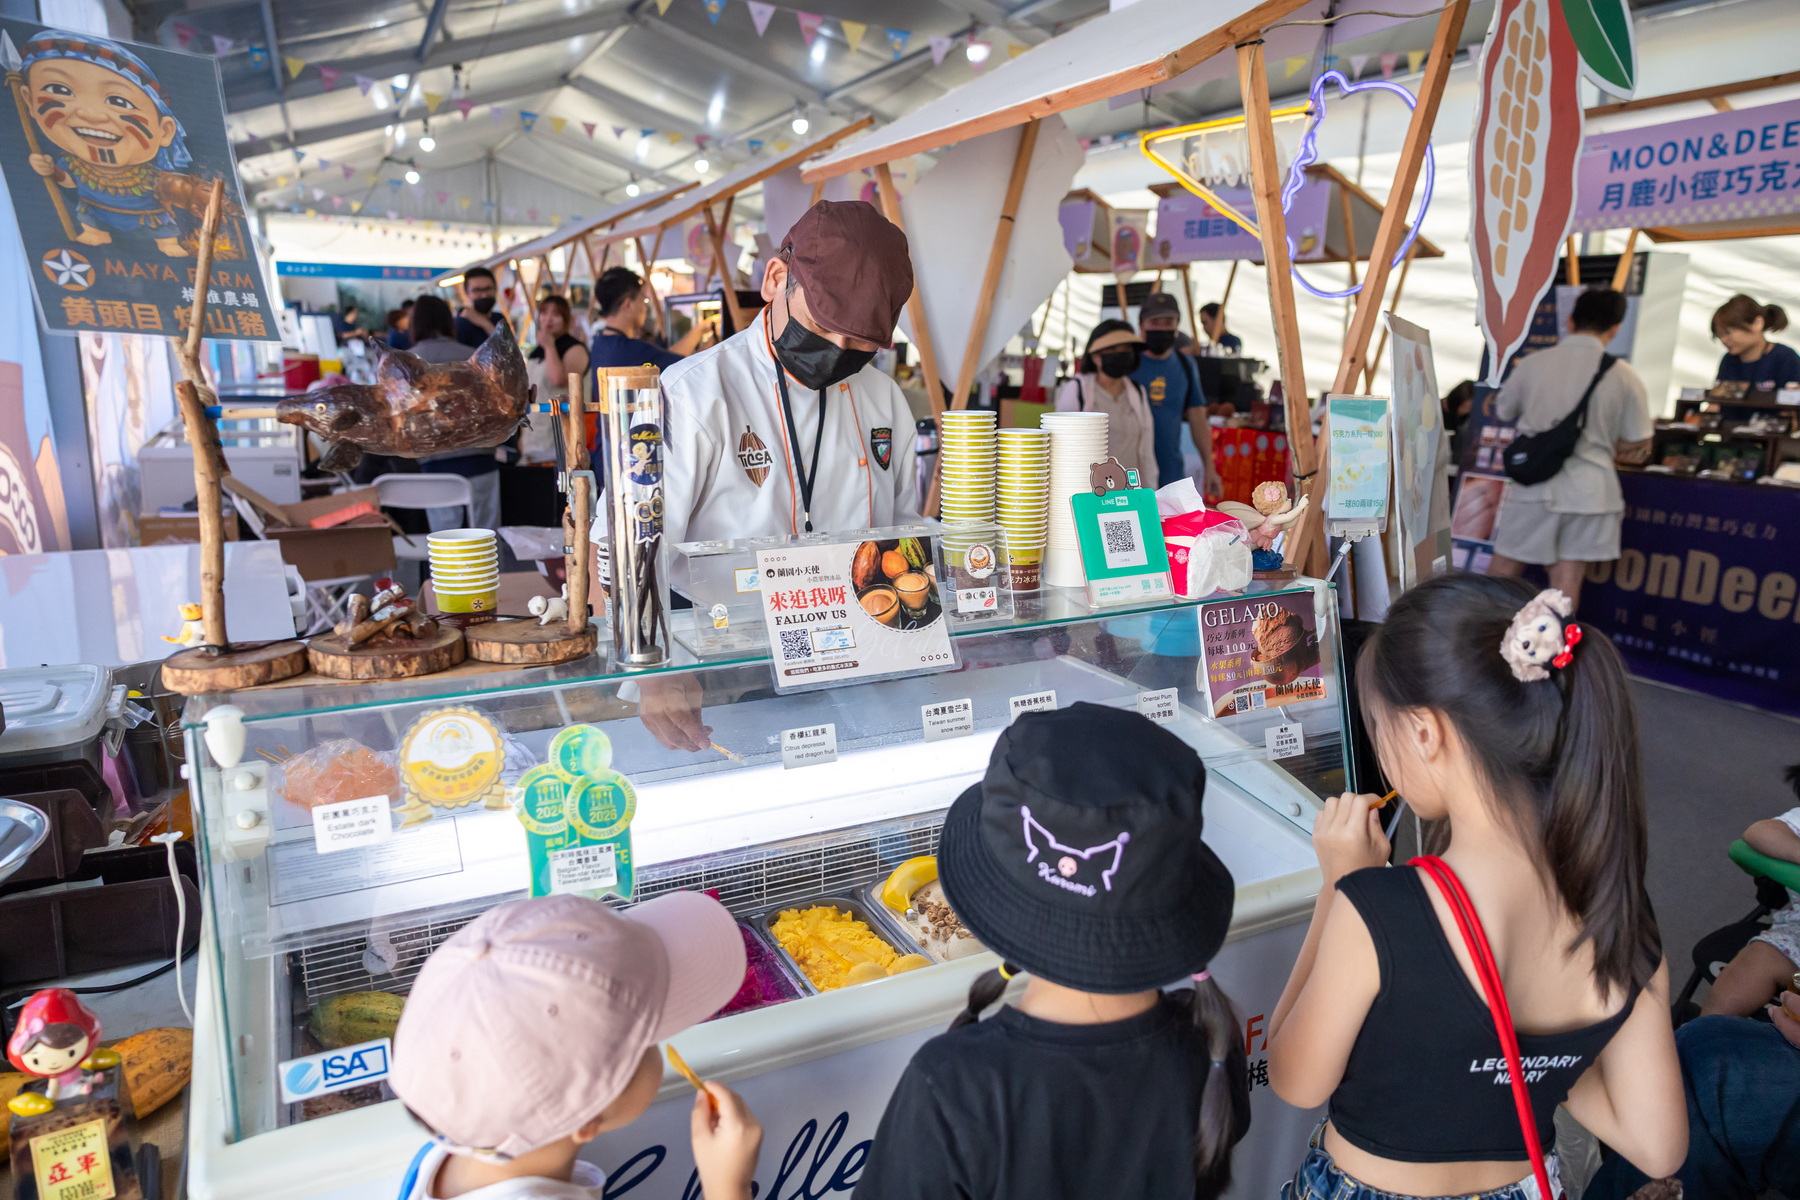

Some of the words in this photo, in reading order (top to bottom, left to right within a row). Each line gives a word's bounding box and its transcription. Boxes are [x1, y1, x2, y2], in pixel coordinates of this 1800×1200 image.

[105, 257, 180, 283] MAYA
[1101, 498, 1115, 506] LINE
[769, 585, 848, 613] 來追我呀
[775, 611, 828, 626] FALLOW
[831, 609, 848, 620] US
[1204, 601, 1279, 628] GELATO
[1206, 629, 1246, 643] 巧克力系列
[1210, 657, 1243, 671] 水果系列
[925, 703, 970, 718] 台灣夏雪芒果
[928, 718, 945, 726] Taiwan
[946, 716, 966, 724] summer
[955, 724, 971, 733] mango
[784, 743, 800, 752] Citrus
[805, 750, 823, 760] dragon
[824, 748, 835, 756] fruit
[357, 817, 377, 828] dark
[589, 808, 618, 824] 2026
[322, 1051, 369, 1081] ISA
[1469, 1055, 1582, 1073] LEGNDARY
